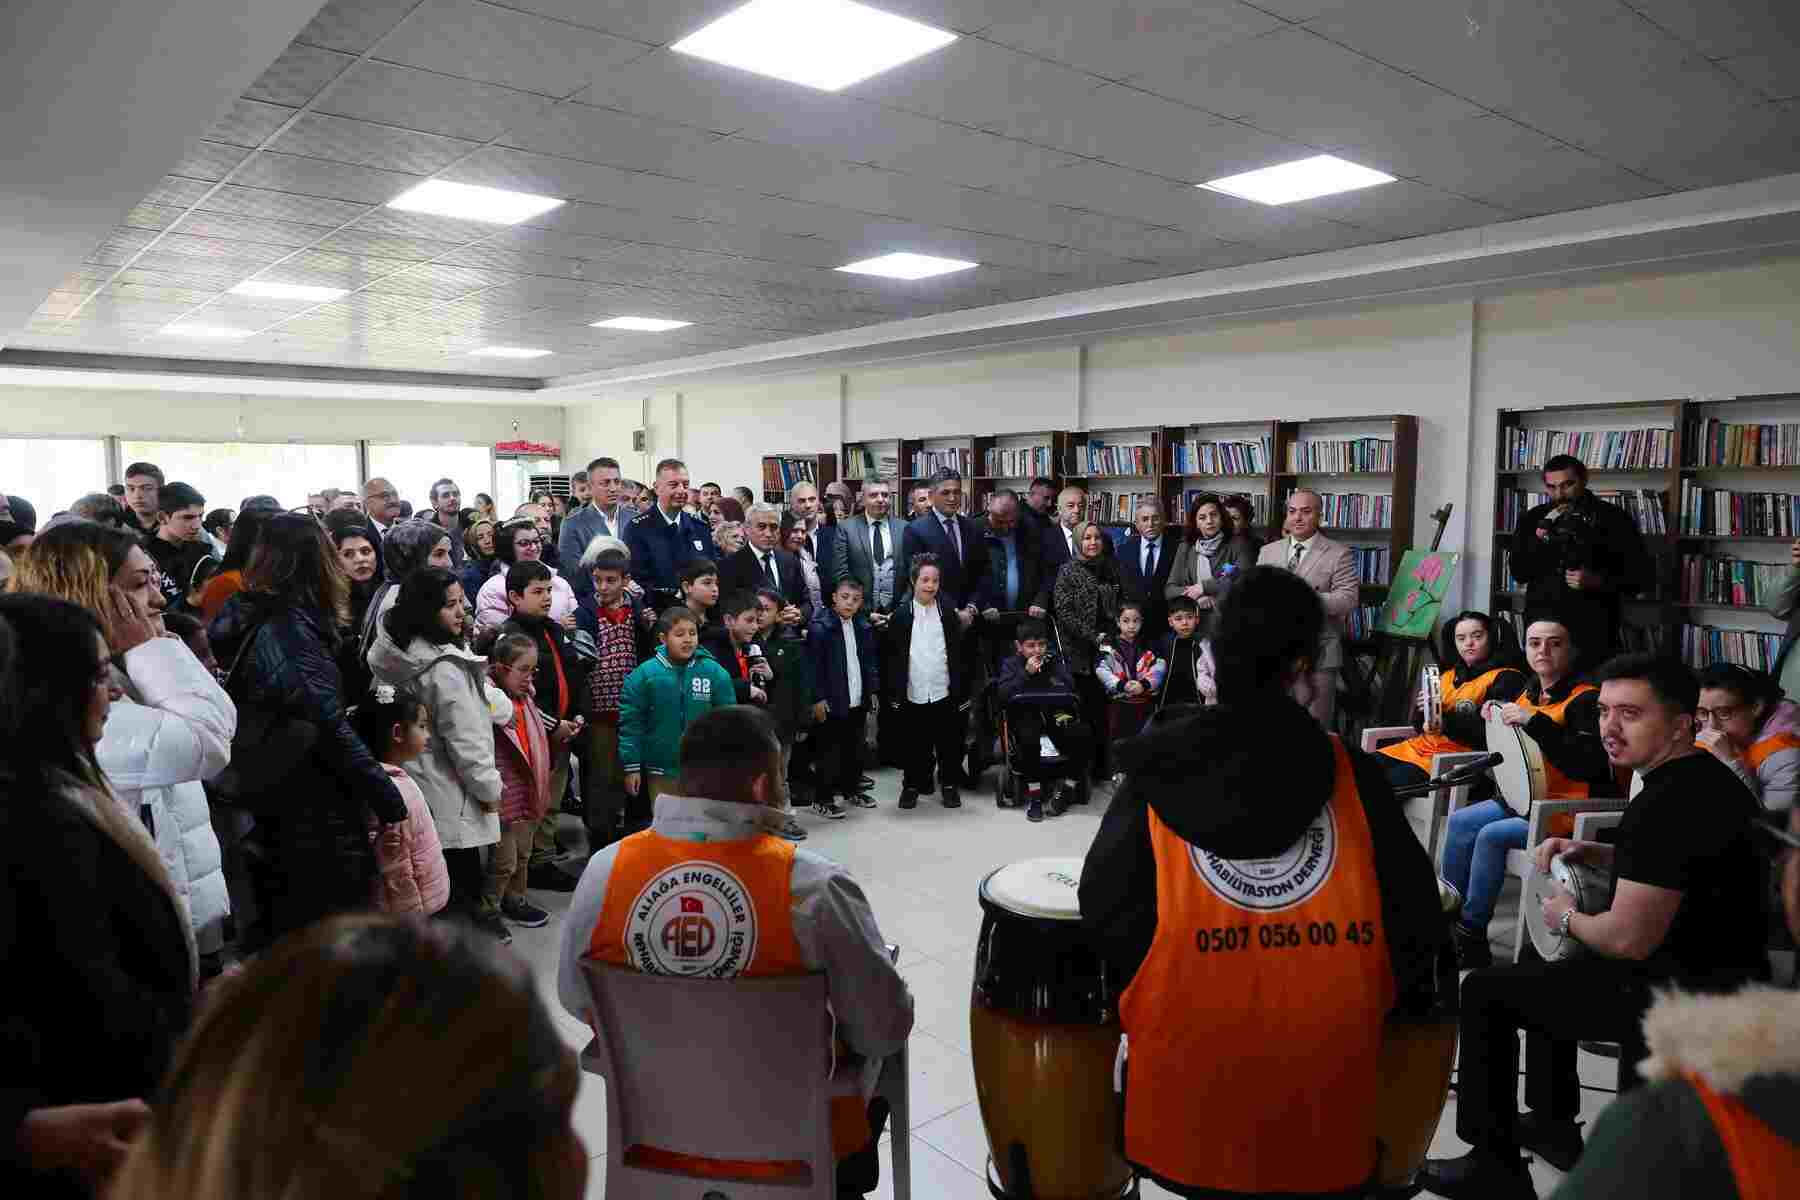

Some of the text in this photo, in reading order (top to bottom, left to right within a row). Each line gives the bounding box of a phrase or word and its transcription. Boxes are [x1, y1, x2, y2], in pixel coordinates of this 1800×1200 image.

[683, 871, 745, 924] ENGELLİLER
[1196, 919, 1376, 952] 0507 056 00 45
